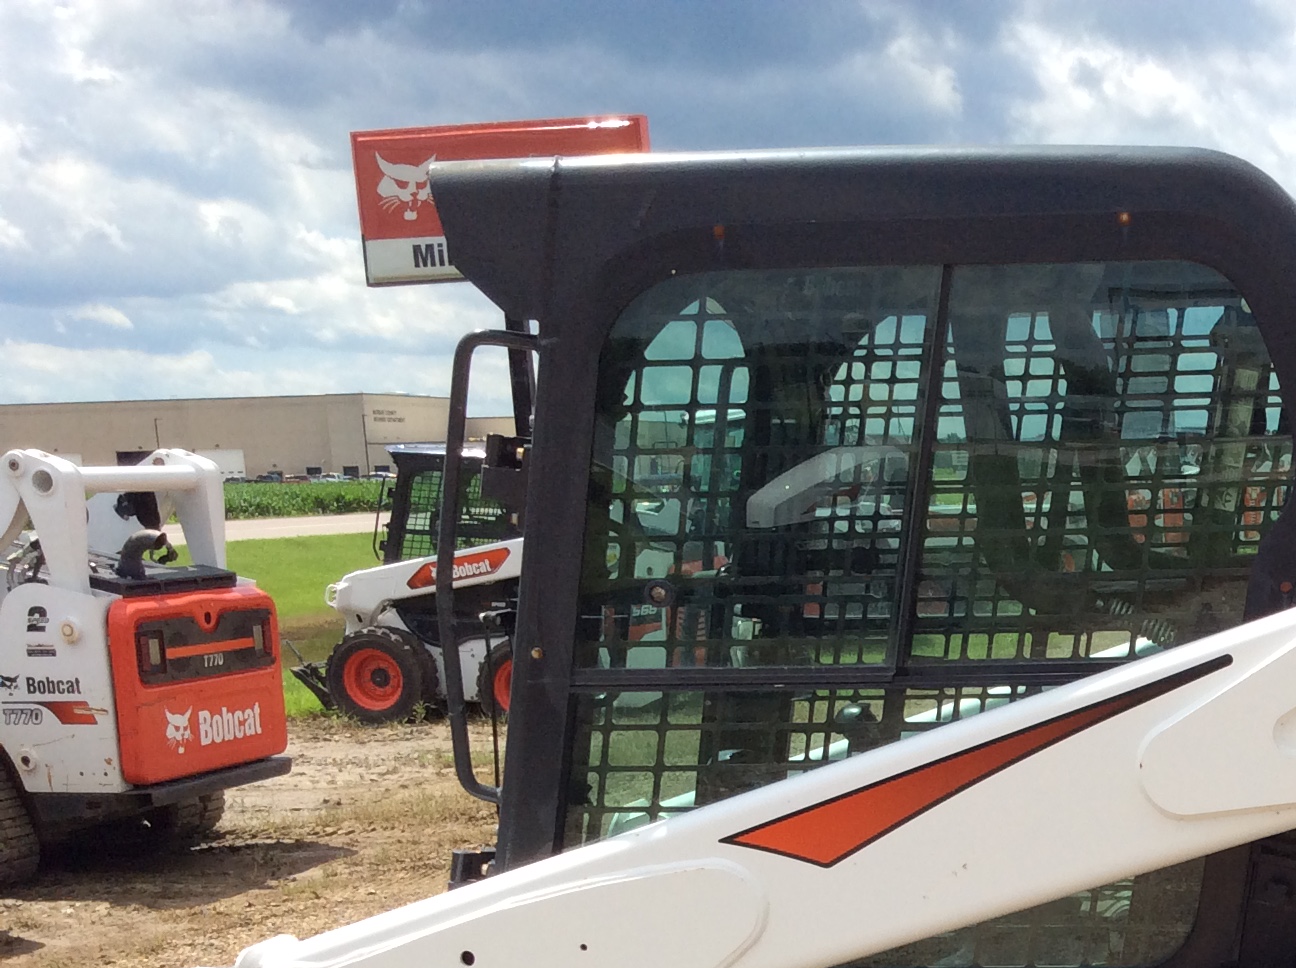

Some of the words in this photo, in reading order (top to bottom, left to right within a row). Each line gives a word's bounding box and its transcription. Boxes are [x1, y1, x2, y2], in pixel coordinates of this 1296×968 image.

[412, 243, 453, 268] Mi
[452, 558, 492, 579] Bobcat
[26, 605, 48, 632] 2
[203, 652, 224, 668] T770
[26, 676, 82, 695] Bobcat
[3, 708, 43, 725] T770
[198, 702, 262, 746] Bobcat
